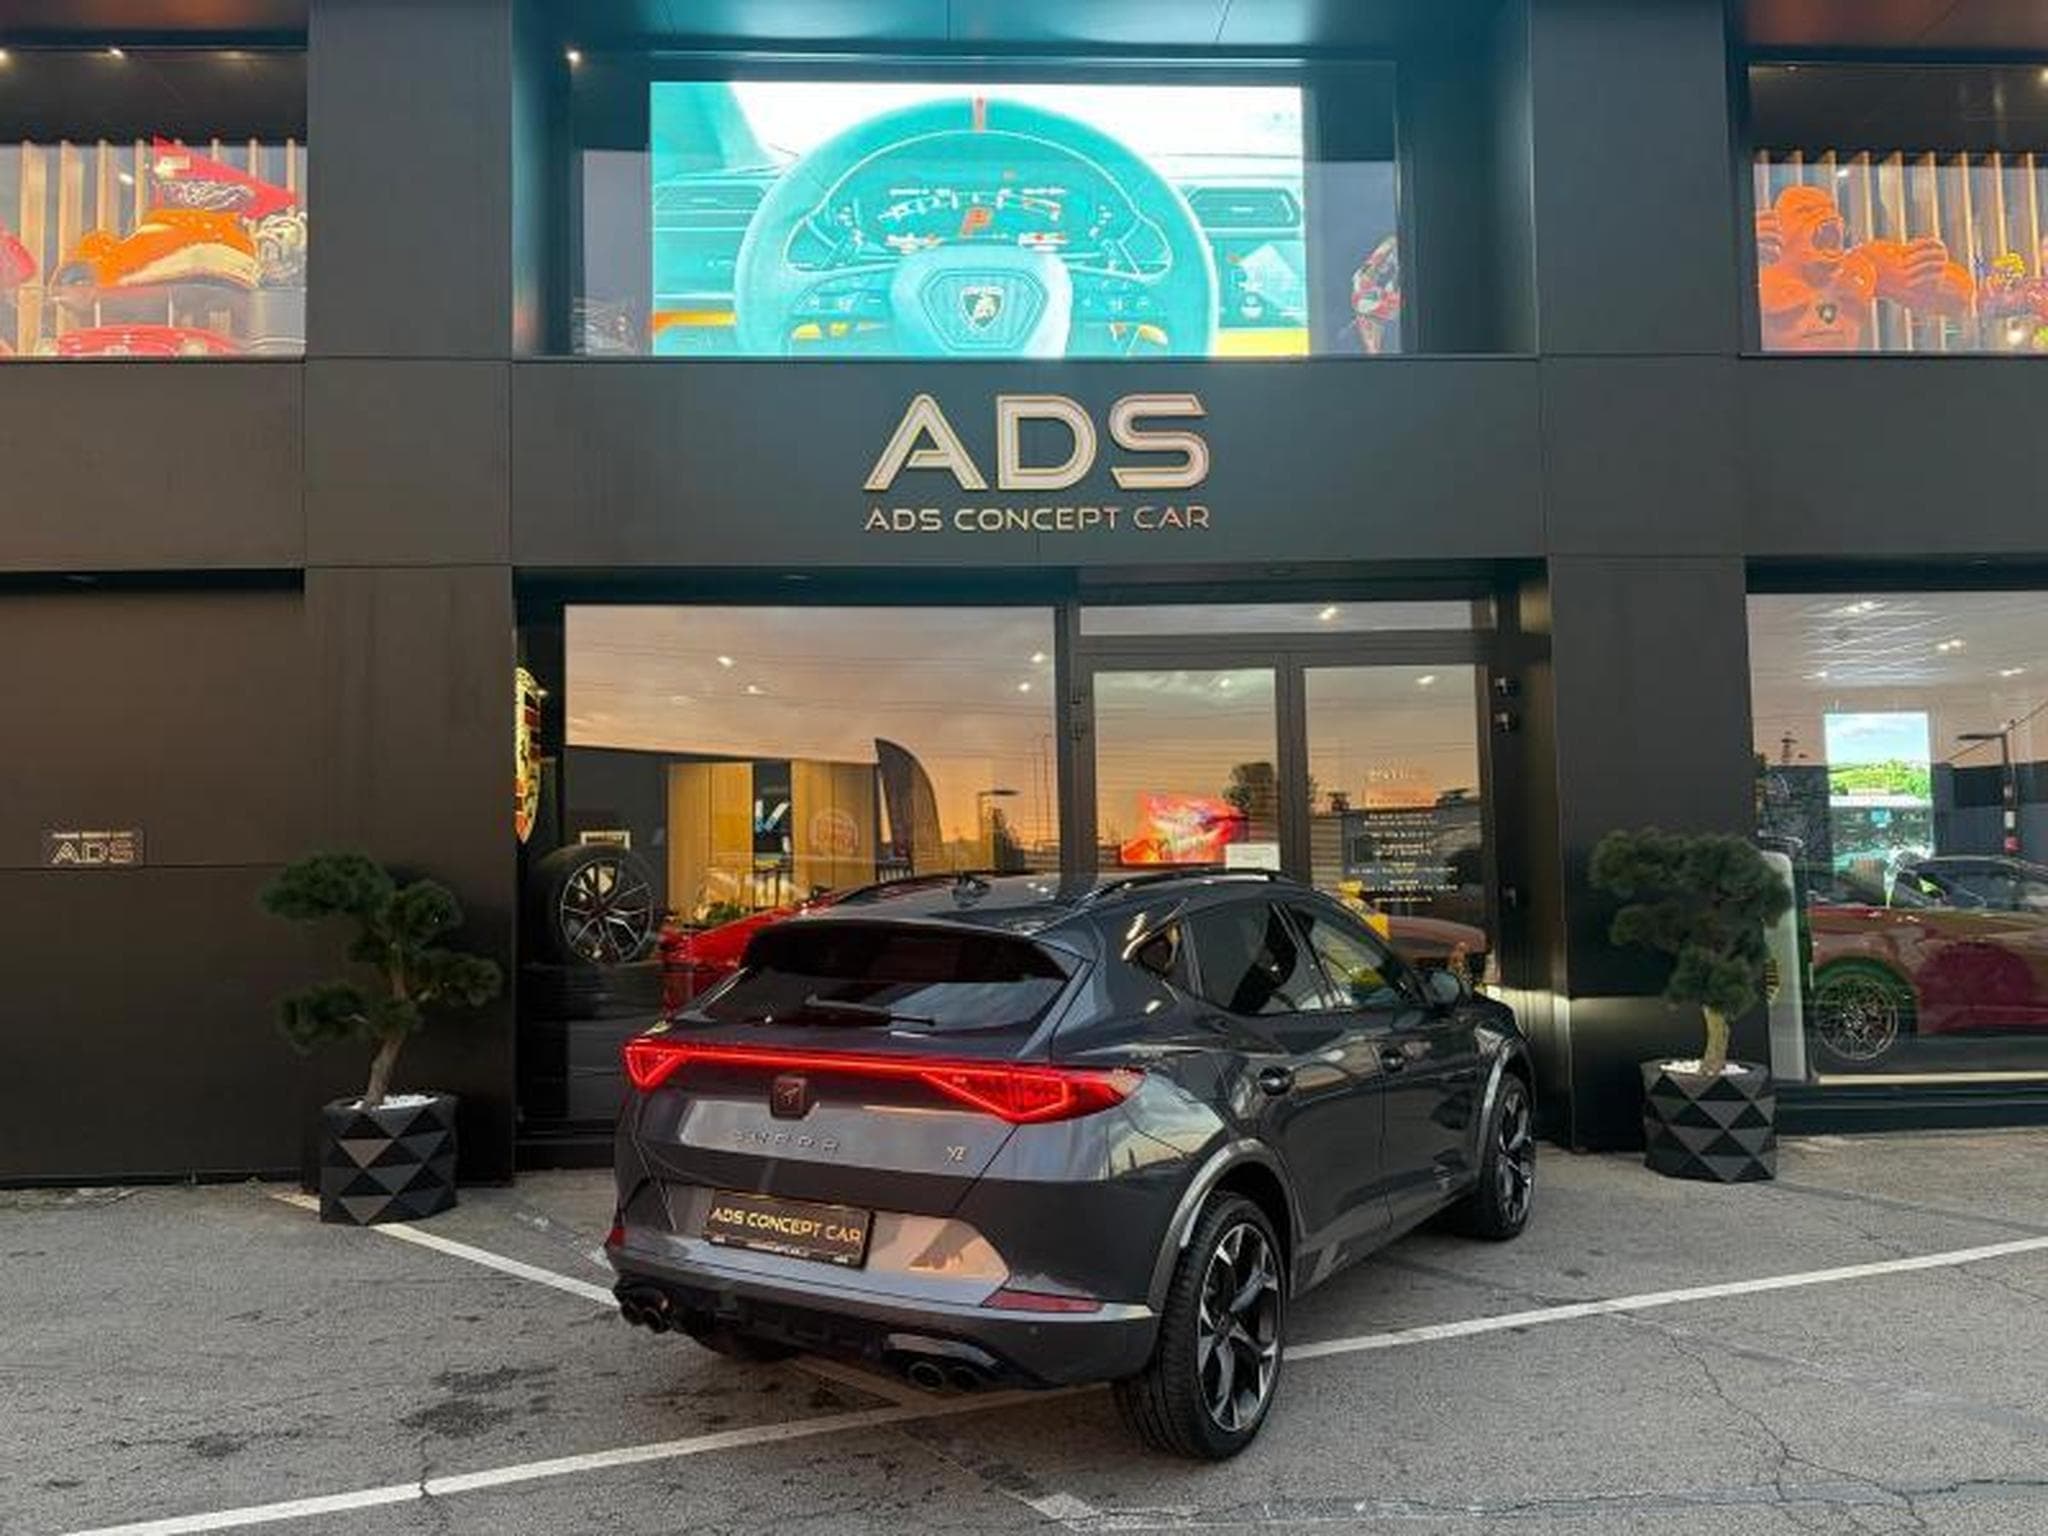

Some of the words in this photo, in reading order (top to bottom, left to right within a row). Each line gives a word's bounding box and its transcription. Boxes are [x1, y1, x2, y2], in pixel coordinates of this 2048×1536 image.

[863, 393, 1210, 490] ADS
[864, 507, 943, 532] ADS
[955, 507, 1121, 532] CONCEPT
[1133, 505, 1211, 529] CAR
[51, 841, 135, 865] ADS
[710, 1207, 746, 1225] ADS
[747, 1211, 822, 1238] CONCEPT
[825, 1225, 862, 1243] CAR
